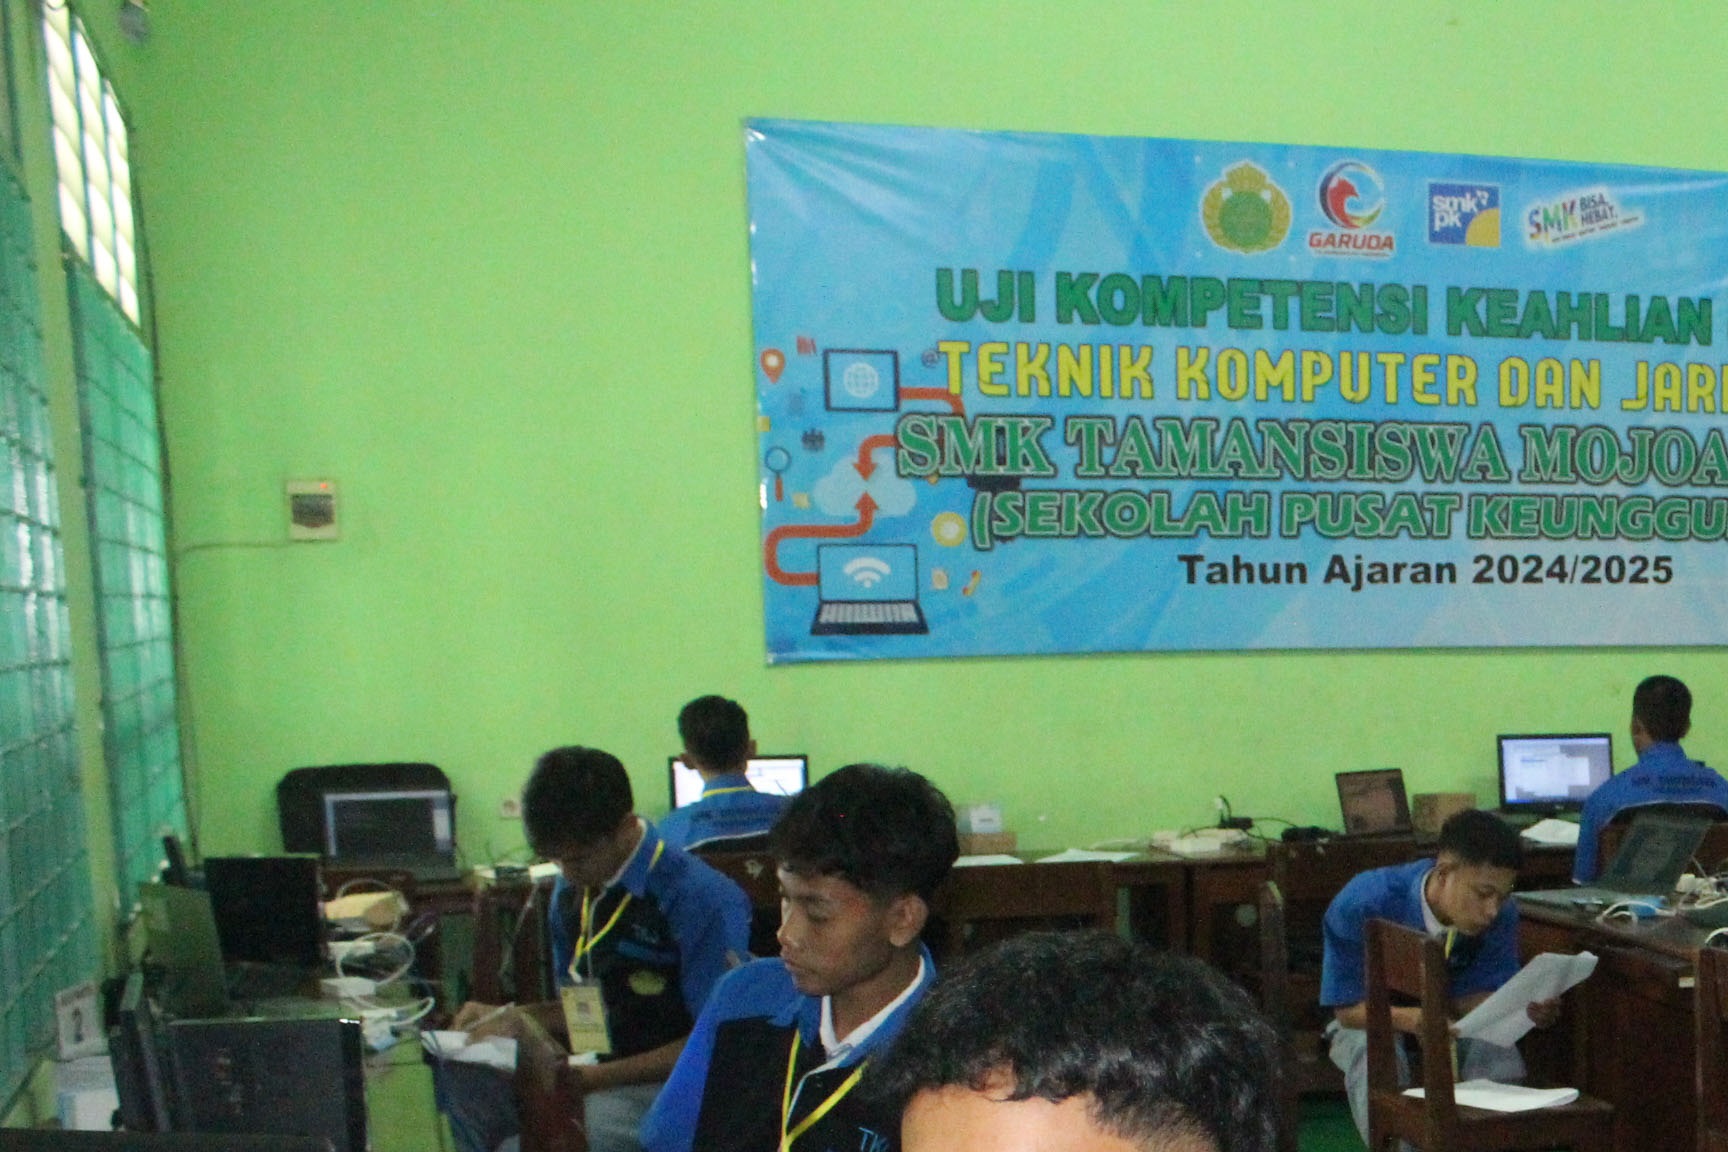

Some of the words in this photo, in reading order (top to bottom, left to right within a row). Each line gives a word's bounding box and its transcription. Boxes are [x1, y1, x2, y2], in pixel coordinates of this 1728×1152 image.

[1309, 232, 1394, 251] GARUDA
[935, 268, 1036, 325] UJI
[1056, 271, 1427, 336] KOMPETENSI
[1447, 286, 1712, 347] KEAHLIAN
[938, 341, 1154, 400] TEKNIK
[1175, 344, 1478, 406] KOMPUTER
[1498, 356, 1601, 410] DAN
[896, 414, 1056, 480] SMK
[1066, 417, 1511, 485] TAMANSISWA
[971, 490, 1273, 551] (SEKOLAH
[1281, 494, 1463, 541] PUSAT
[1178, 554, 1308, 585] Tahun
[1323, 555, 1457, 593] Ajaran
[1473, 553, 1673, 585] 2024/2025
